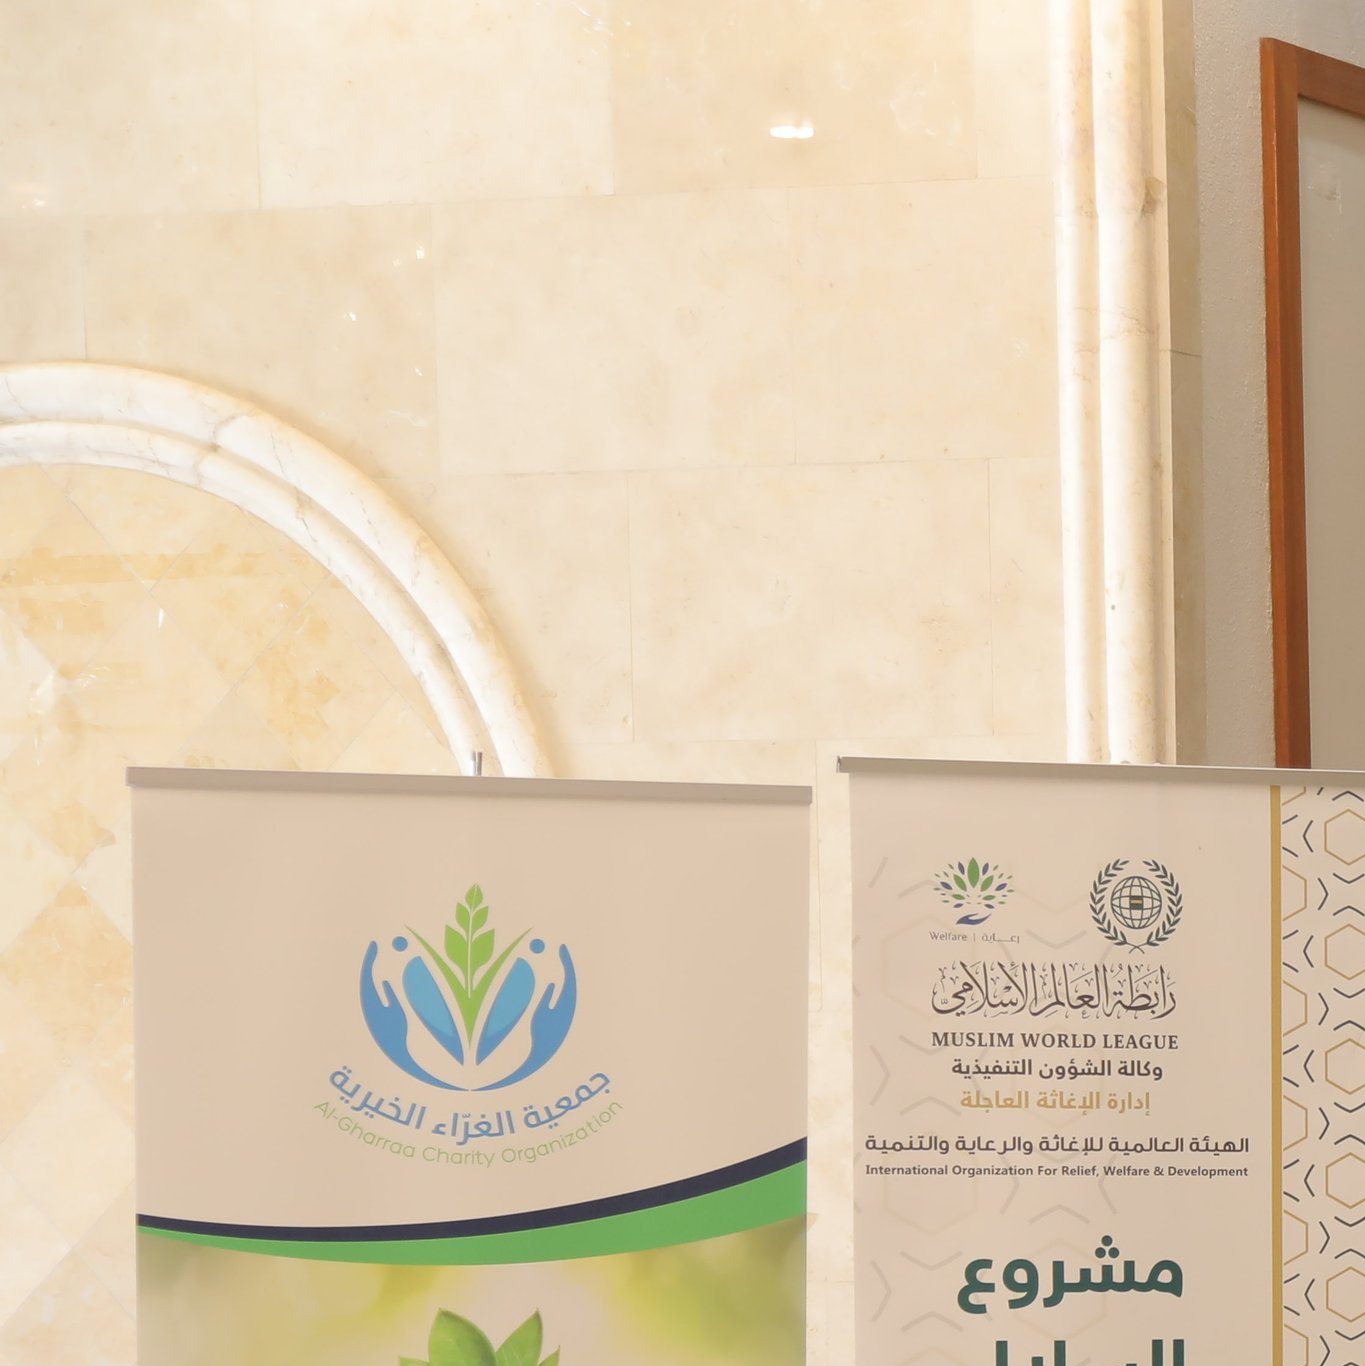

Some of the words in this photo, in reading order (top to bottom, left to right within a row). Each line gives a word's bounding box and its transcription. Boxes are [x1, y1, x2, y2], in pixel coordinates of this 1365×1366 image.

[929, 931, 968, 942] Welfare
[931, 1031, 1015, 1048] MUSLIM
[1021, 1033, 1096, 1049] WORLD
[1103, 1034, 1179, 1050] LEAGUE
[952, 1058, 1032, 1079] التنفيذية
[1039, 1058, 1111, 1080] الشؤون
[1118, 1060, 1163, 1080] وكالة
[329, 1065, 426, 1130] الخيرية
[523, 1072, 611, 1129] جمعية
[960, 1090, 1029, 1113] العاجلة
[1036, 1090, 1100, 1116] الإغاثة
[1107, 1092, 1150, 1116] إدارة
[313, 1101, 416, 1158] Al-Gharraa
[422, 1147, 495, 1168] Charity
[502, 1101, 623, 1163] Organization
[866, 1135, 949, 1155] والتنمية
[1039, 1134, 1103, 1156] للإغاثة
[955, 1136, 1033, 1155] والرعاية
[1109, 1137, 1183, 1156] العالمية
[1189, 1136, 1249, 1156] الهيئة
[865, 1164, 948, 1176] International
[952, 1164, 1033, 1178] Organization
[1037, 1165, 1058, 1176] For
[1061, 1165, 1099, 1177] Relief,
[1103, 1165, 1149, 1176] Welfare
[1153, 1166, 1164, 1176] &
[1167, 1166, 1249, 1178] Development
[957, 1234, 1183, 1314] مشروع
